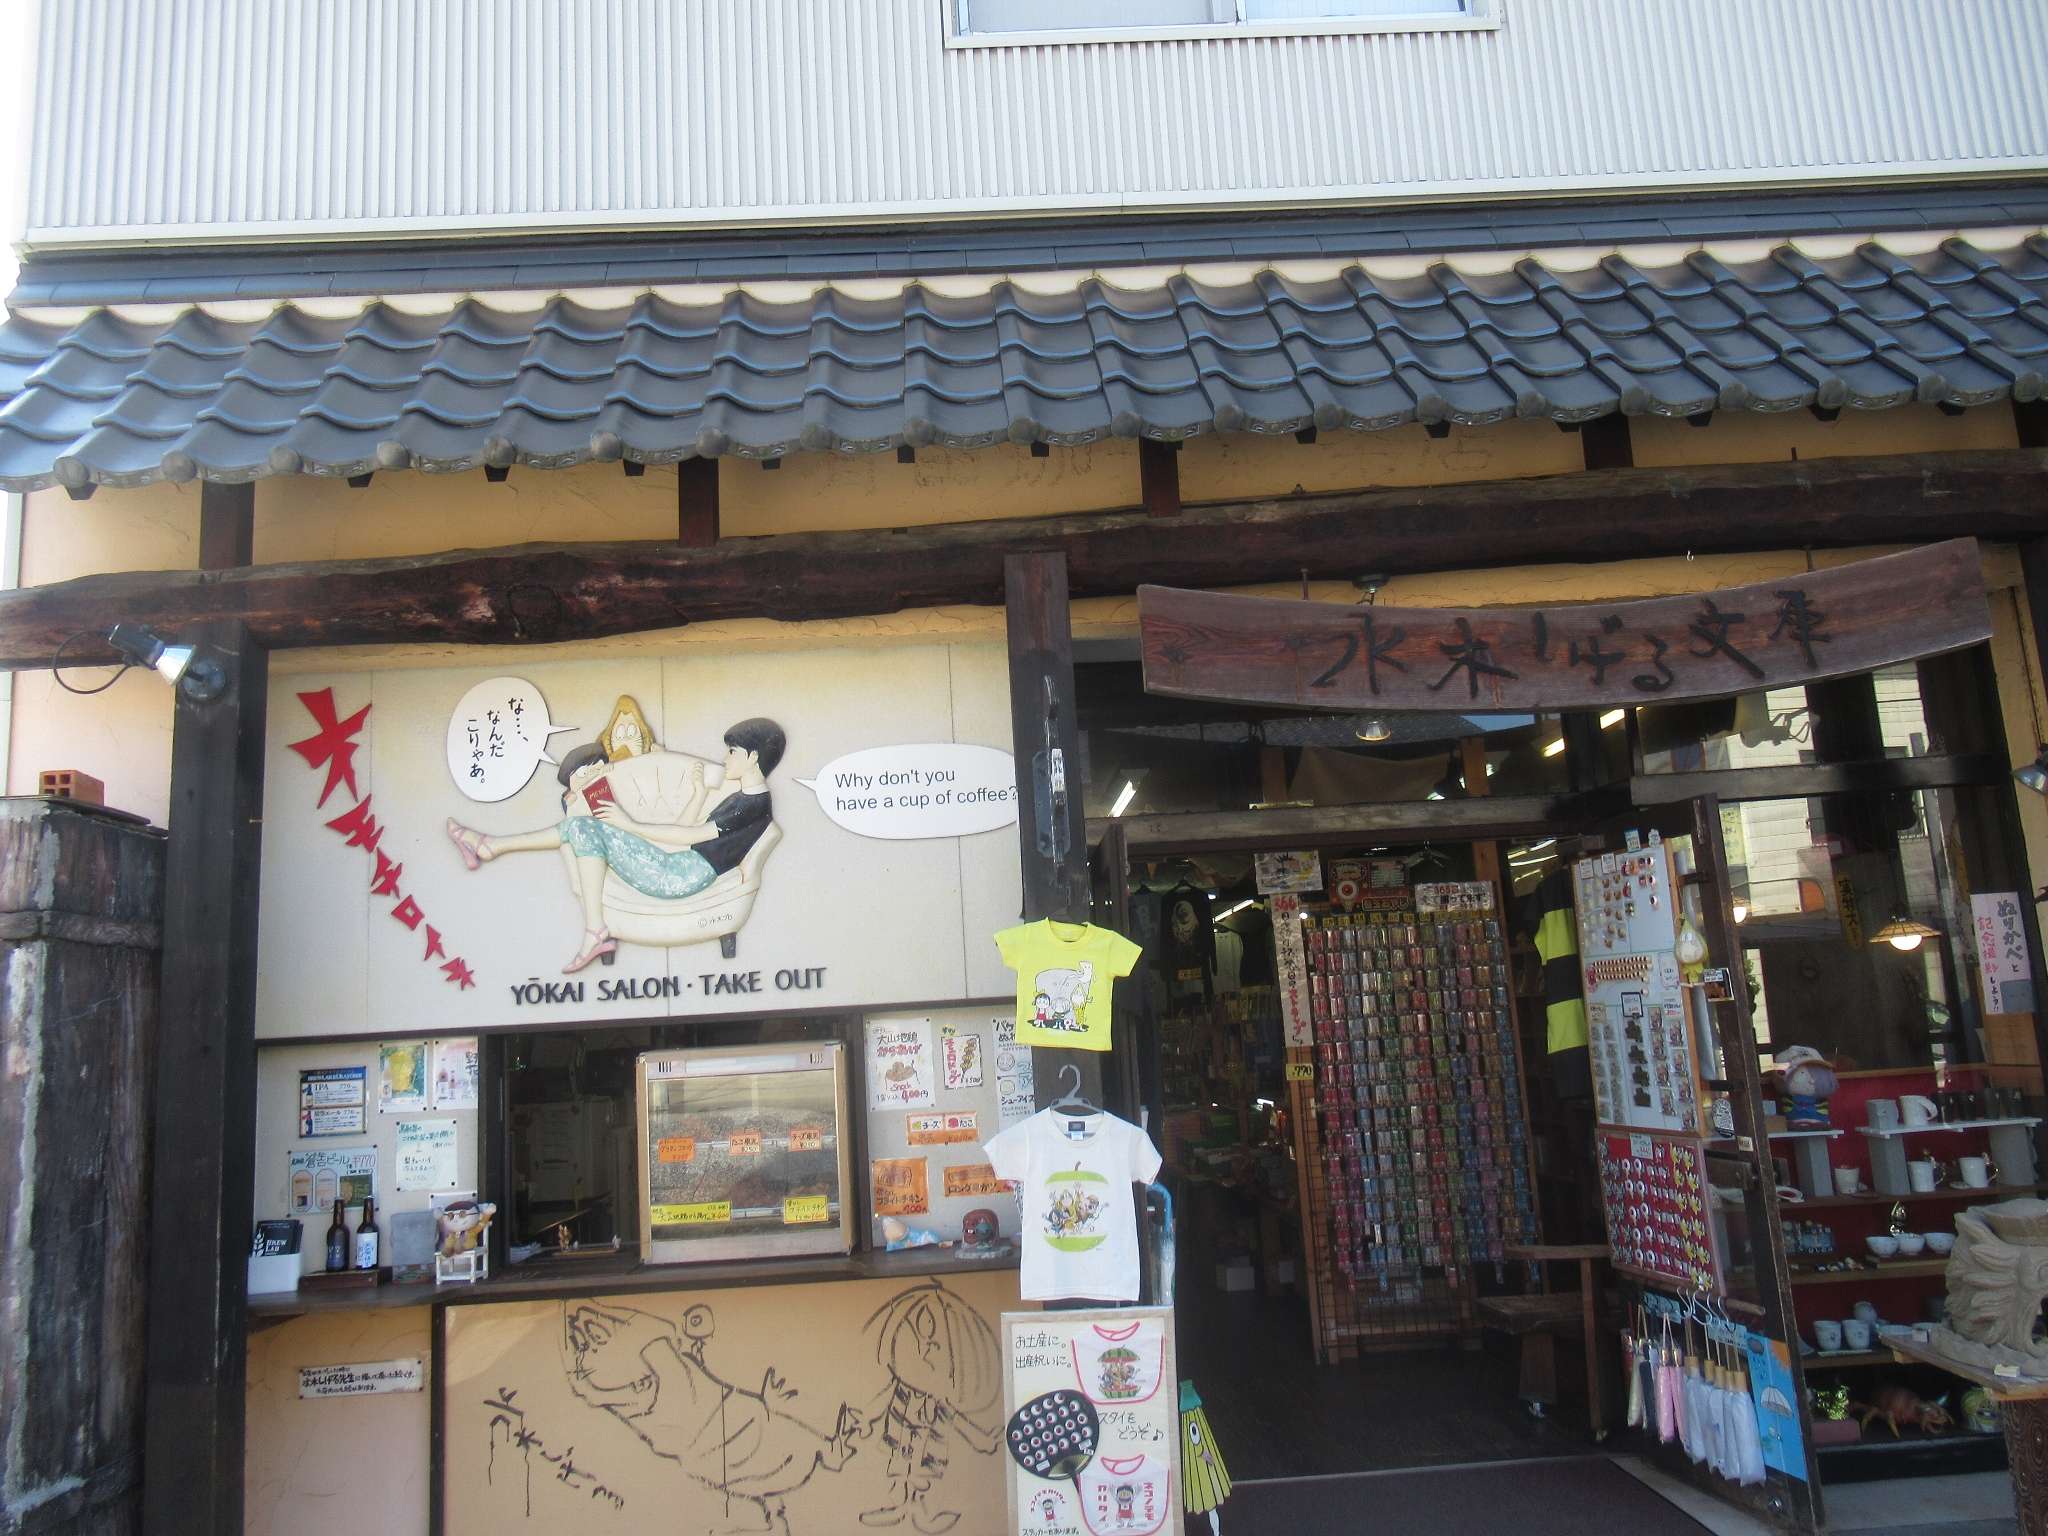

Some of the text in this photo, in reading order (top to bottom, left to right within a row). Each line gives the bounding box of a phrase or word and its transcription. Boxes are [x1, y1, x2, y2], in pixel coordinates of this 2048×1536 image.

[1311, 589, 1831, 697] 水木しげる文庫
[487, 710, 505, 759] なんだ
[466, 719, 488, 784] こりゃあ。
[834, 769, 956, 791] Why don't you
[836, 785, 1018, 811] have a cup of coffee?
[1997, 899, 2023, 972] ぬりかべと
[510, 967, 828, 1006] YŌKAI SALON TAKE OUT
[922, 1119, 974, 1129] チーズ たこ
[1015, 1331, 1067, 1349] お土産に。
[1015, 1355, 1072, 1368] 出産祝いに。
[1099, 1411, 1136, 1425] スタイを
